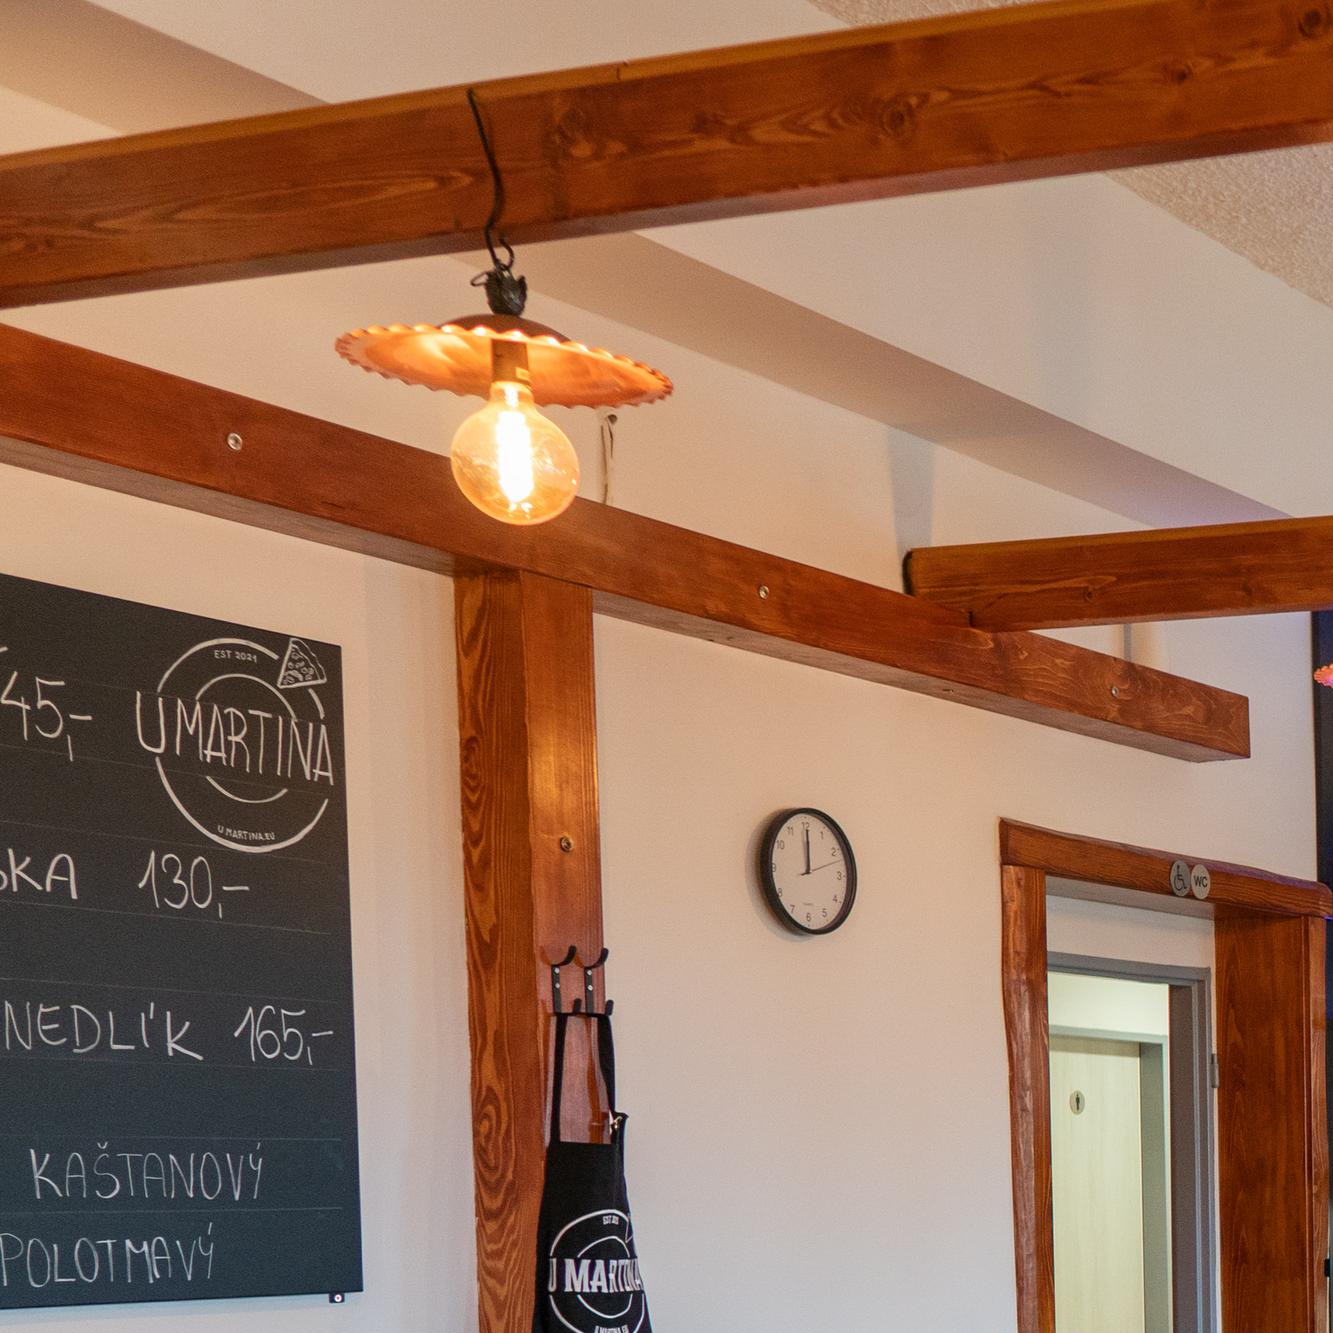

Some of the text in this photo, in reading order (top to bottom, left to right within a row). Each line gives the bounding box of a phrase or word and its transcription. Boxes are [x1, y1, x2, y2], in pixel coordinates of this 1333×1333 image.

[214, 649, 232, 659] EST
[175, 697, 334, 786] MARTINA
[138, 850, 250, 920] 130,-
[1193, 875, 1208, 888] WC
[234, 1005, 334, 1065] 165,-
[29, 1142, 263, 1201] KAŠTANOVÝ
